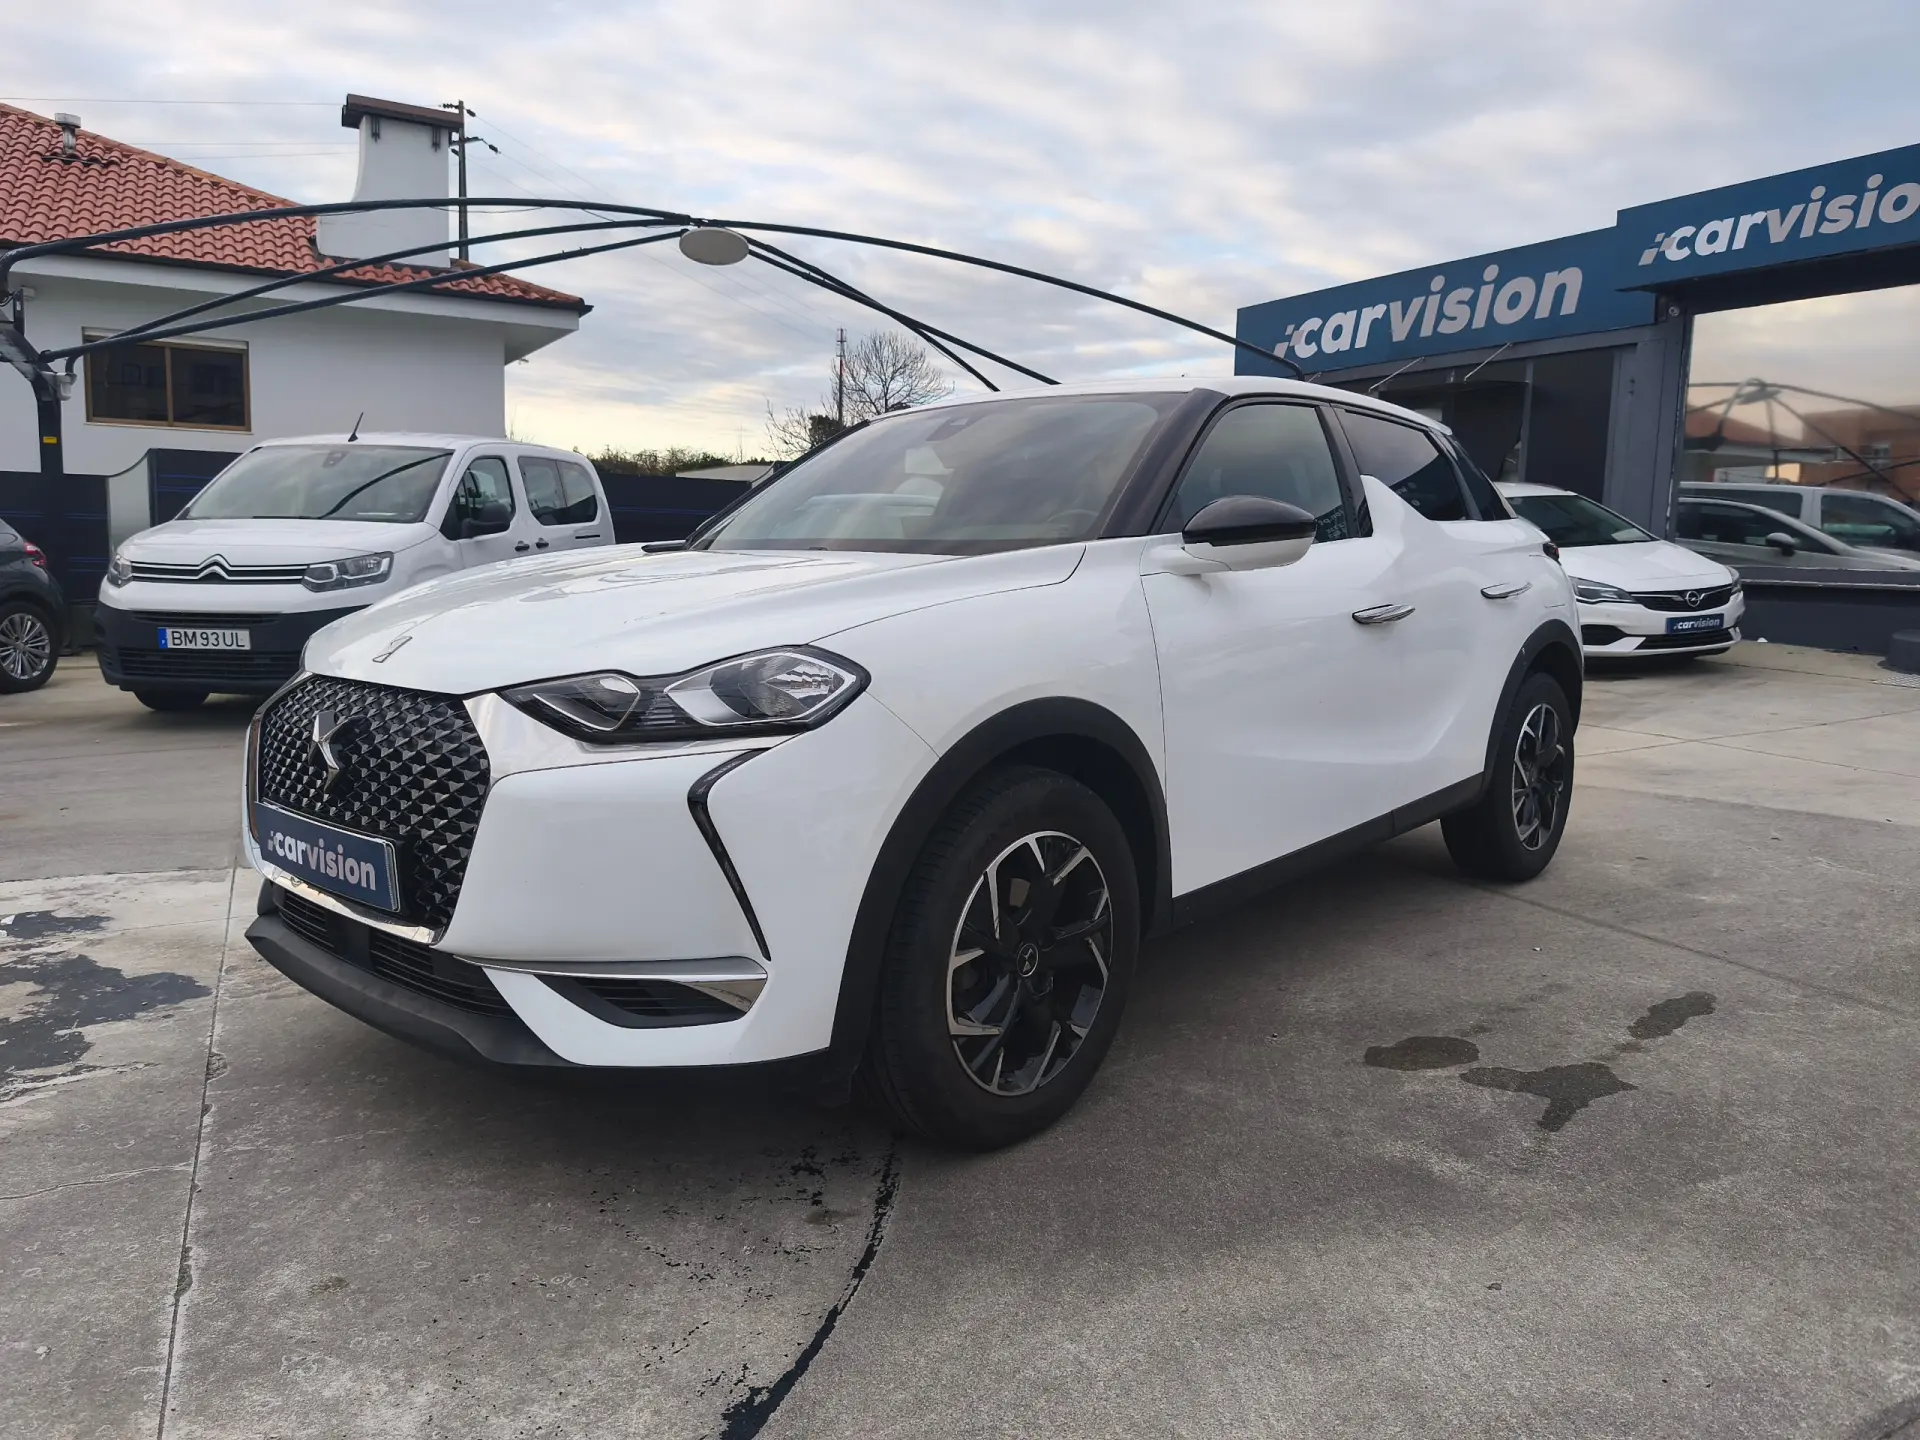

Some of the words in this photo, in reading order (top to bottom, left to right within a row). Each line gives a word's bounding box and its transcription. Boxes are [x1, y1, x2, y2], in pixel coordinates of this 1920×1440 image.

[1289, 264, 1583, 359] carvision
[1676, 617, 1720, 630] carvision
[272, 831, 376, 891] carvision
